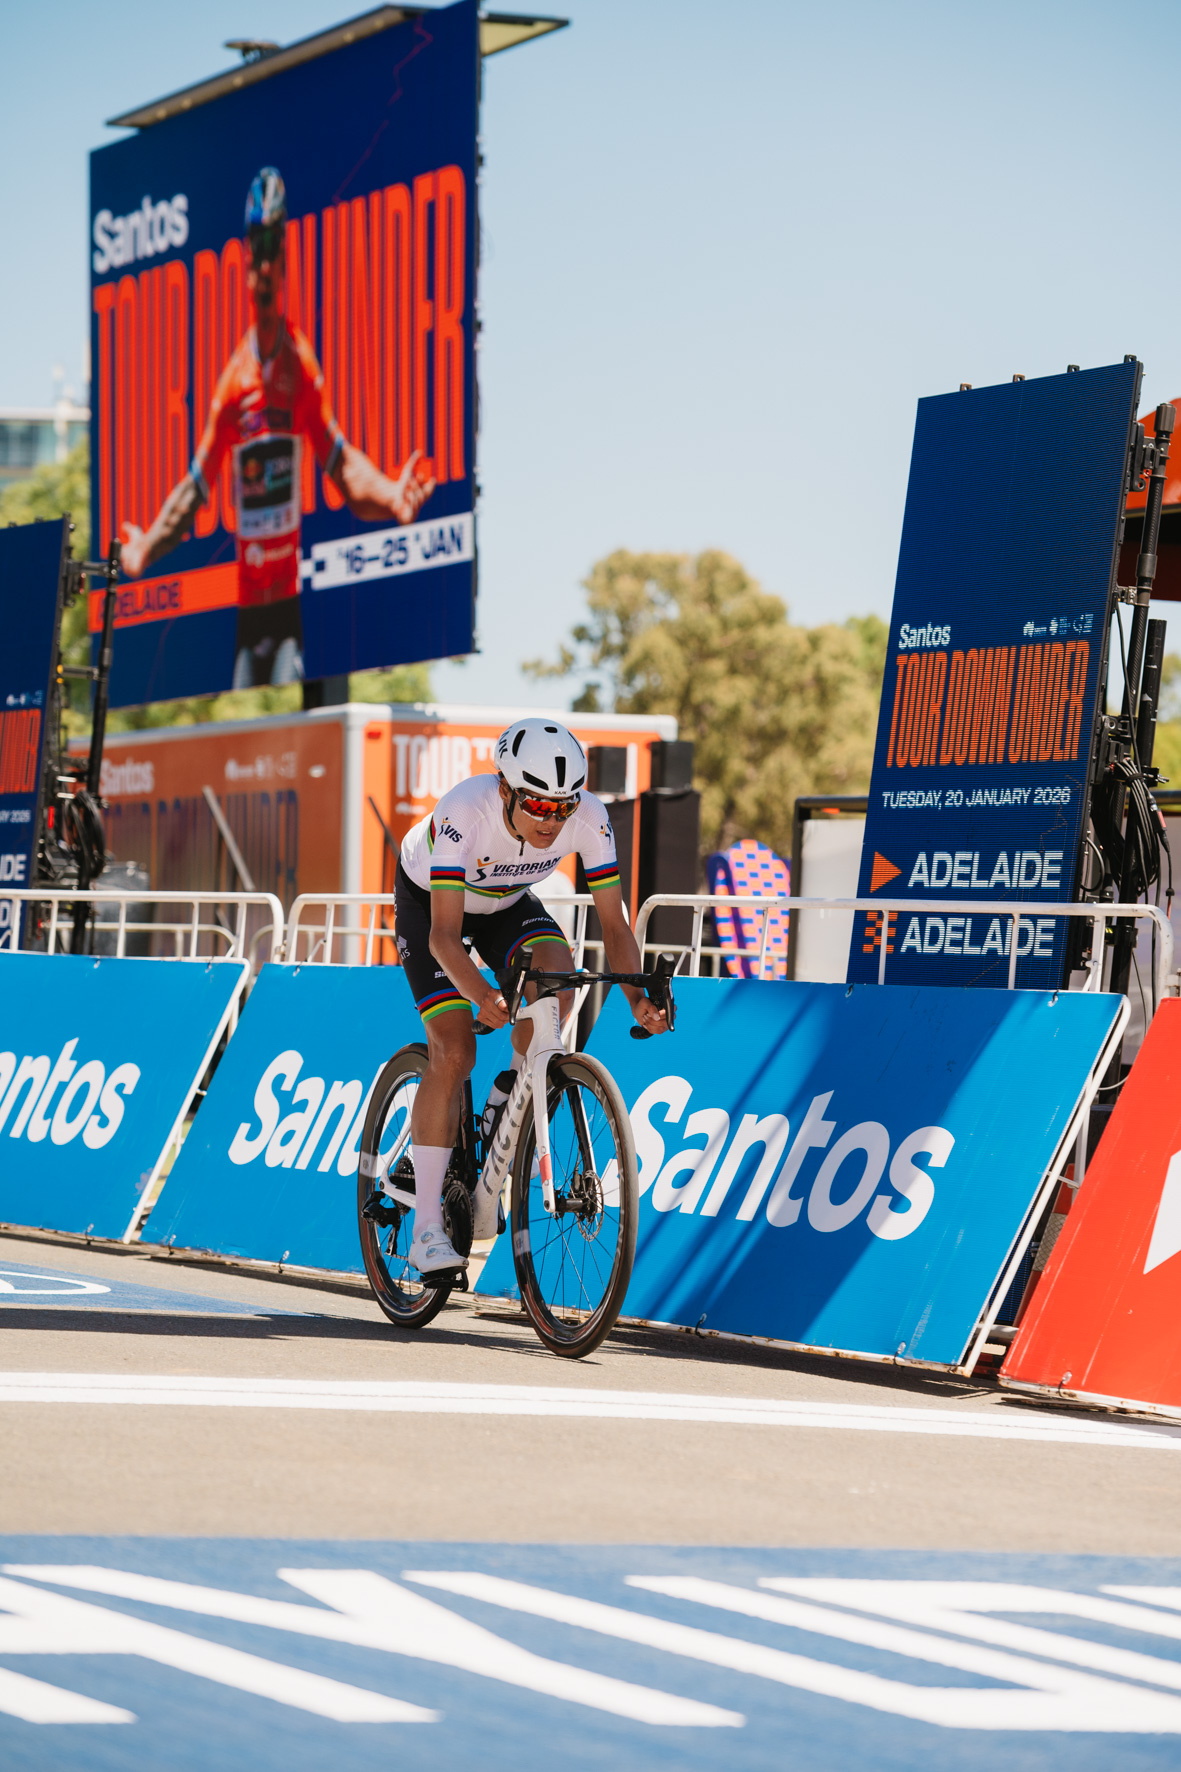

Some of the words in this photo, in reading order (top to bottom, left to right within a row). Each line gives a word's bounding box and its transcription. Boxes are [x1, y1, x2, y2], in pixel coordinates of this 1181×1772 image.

[93, 193, 188, 274] Santos
[93, 259, 189, 559] TOUR
[194, 213, 316, 537] DON
[322, 164, 466, 510] UNDER
[421, 522, 463, 559] JAN
[898, 622, 951, 649] Santos
[886, 651, 948, 768] TOUR
[938, 645, 1017, 766] DOWN
[1008, 640, 1090, 764] UNDER
[392, 734, 471, 799] TOUR
[882, 789, 942, 810] TUESDAY,
[945, 789, 963, 807] 20
[965, 787, 1031, 806] JANUARY
[1033, 785, 1071, 805] 2026
[444, 824, 463, 843] VIS
[492, 856, 562, 873] VICTORIAN
[908, 851, 1064, 888] ADELAIDE
[900, 917, 1056, 956] ADELAIDE
[0, 1037, 141, 1149] ntos
[600, 1075, 955, 1240] Santos
